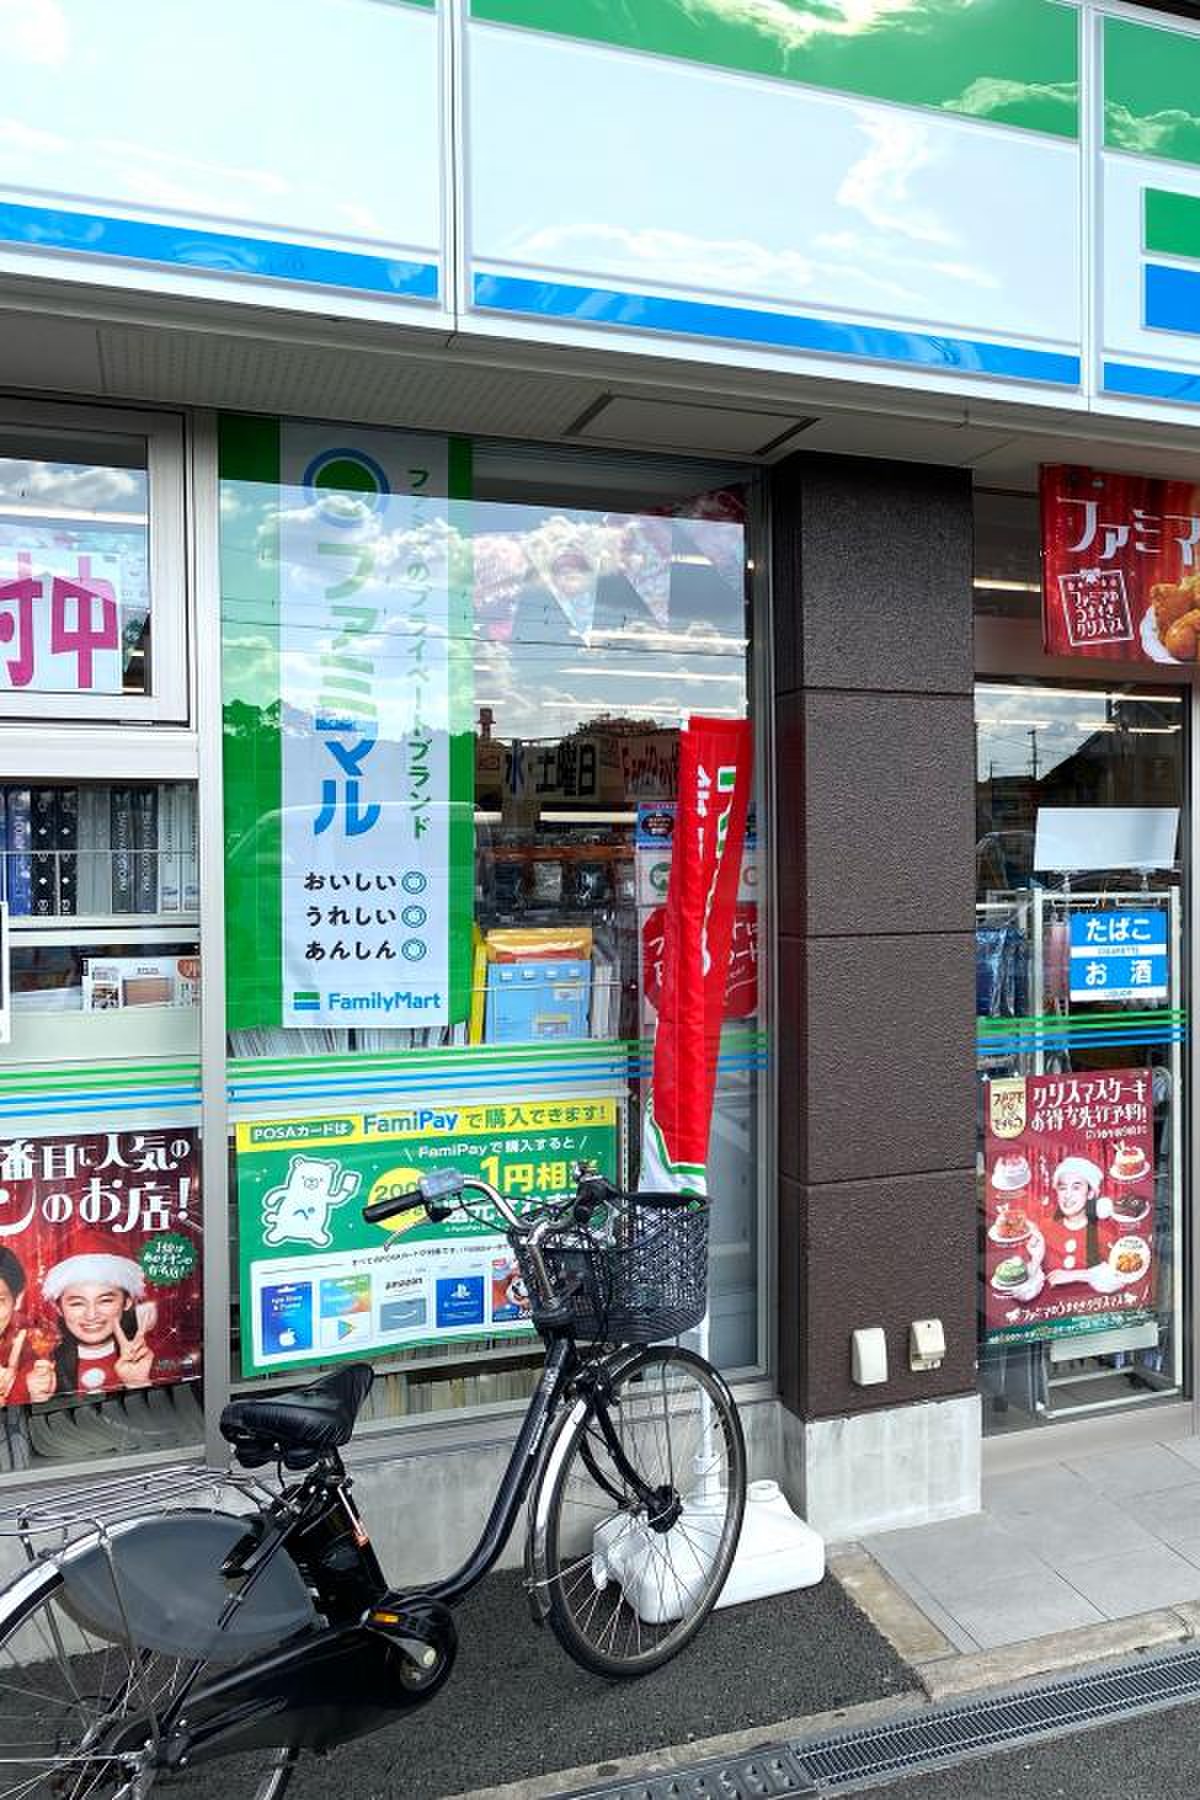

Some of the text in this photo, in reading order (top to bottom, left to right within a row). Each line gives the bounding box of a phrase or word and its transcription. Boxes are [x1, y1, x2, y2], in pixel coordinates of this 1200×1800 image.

[304, 871, 397, 892] おいしい
[305, 905, 397, 927] うれしい
[1086, 917, 1152, 942] たばこ
[304, 940, 397, 962] あんしん
[328, 990, 441, 1013] FamilyMart
[1033, 1078, 1148, 1109] クリスマスケーキ
[363, 1109, 460, 1134] FamiPay
